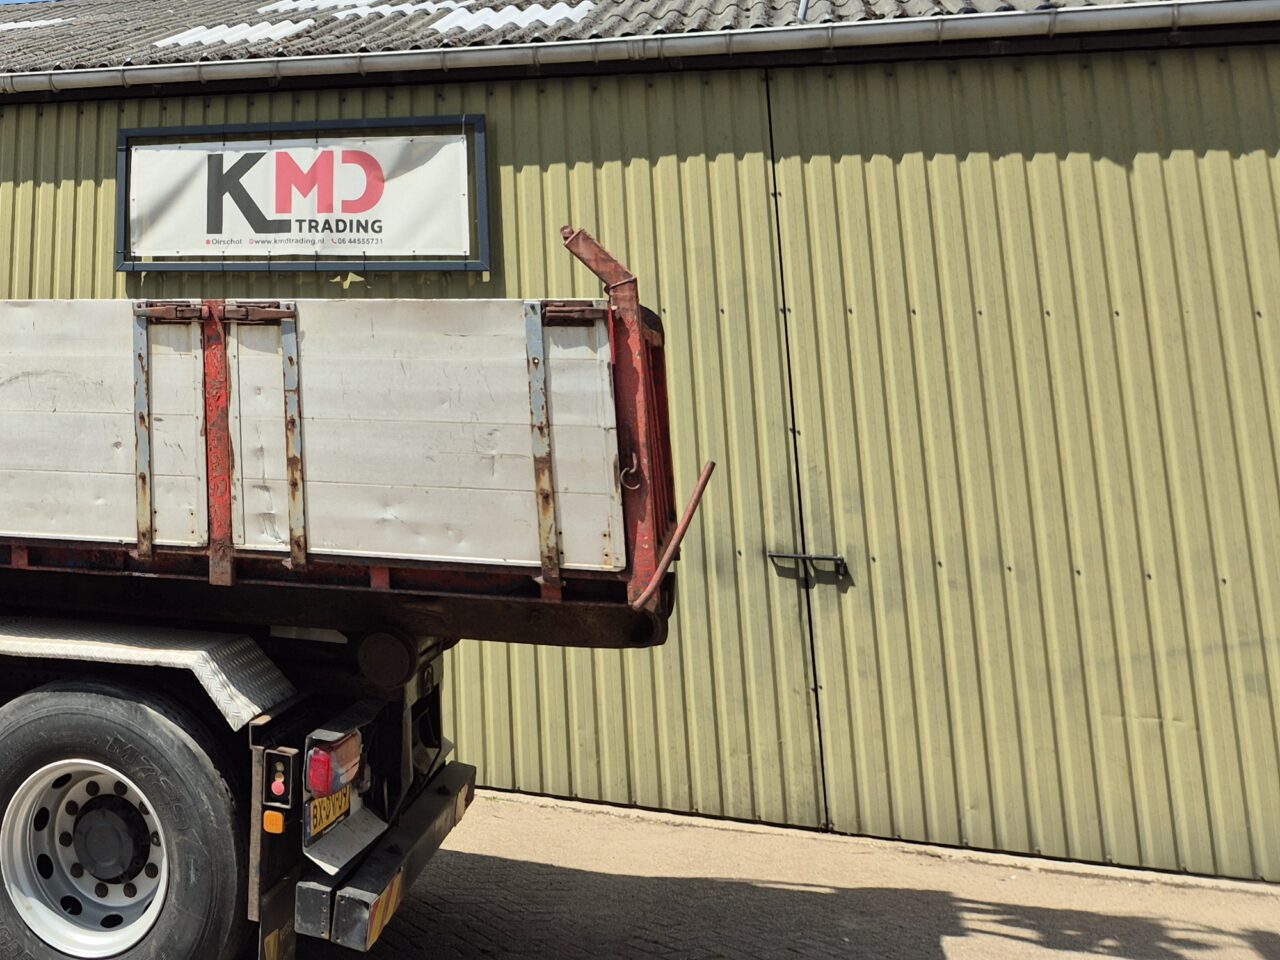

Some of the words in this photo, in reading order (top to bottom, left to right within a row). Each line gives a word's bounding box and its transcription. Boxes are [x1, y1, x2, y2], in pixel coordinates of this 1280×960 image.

[206, 150, 384, 235] KMD
[294, 218, 383, 234] TRADING
[211, 237, 242, 245] Oirschot
[254, 237, 325, 246] www.kmdtrading.nl
[337, 237, 347, 245] 06
